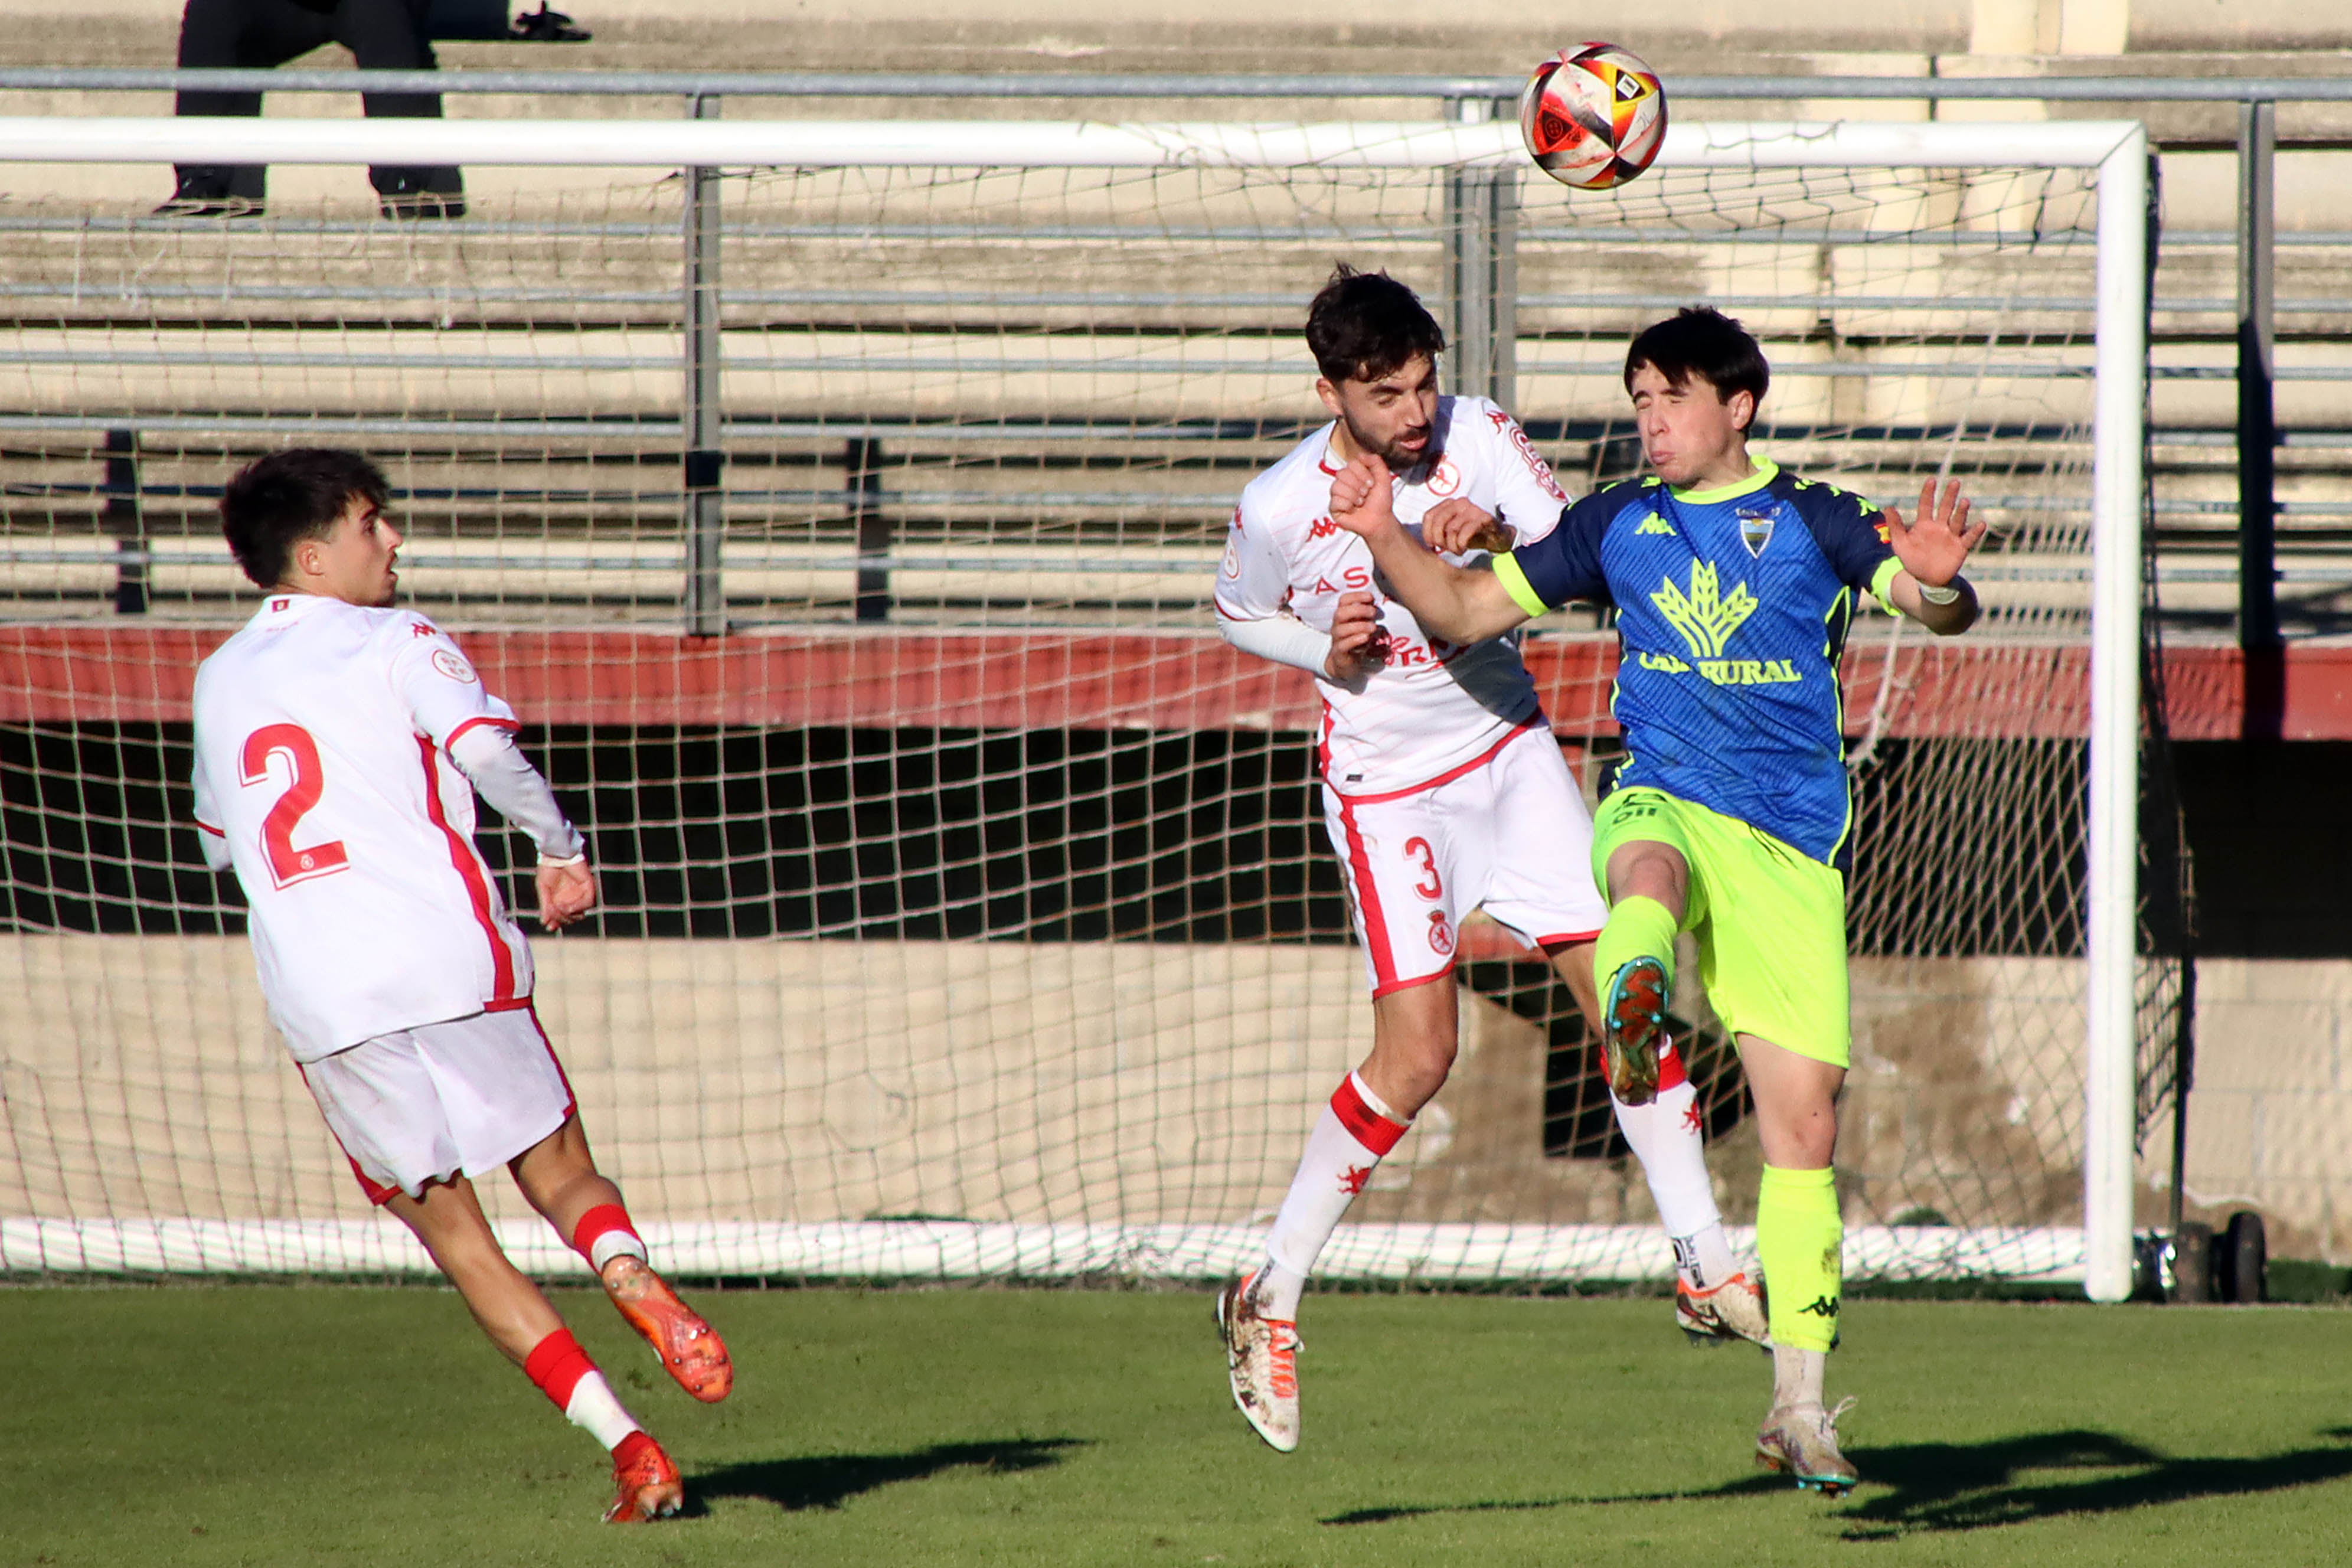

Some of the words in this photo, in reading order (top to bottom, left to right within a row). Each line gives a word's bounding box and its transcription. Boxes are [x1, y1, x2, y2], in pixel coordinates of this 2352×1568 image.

[1697, 659, 1802, 685] RURAL
[238, 723, 351, 891] 2
[1402, 836, 1443, 902] 3
